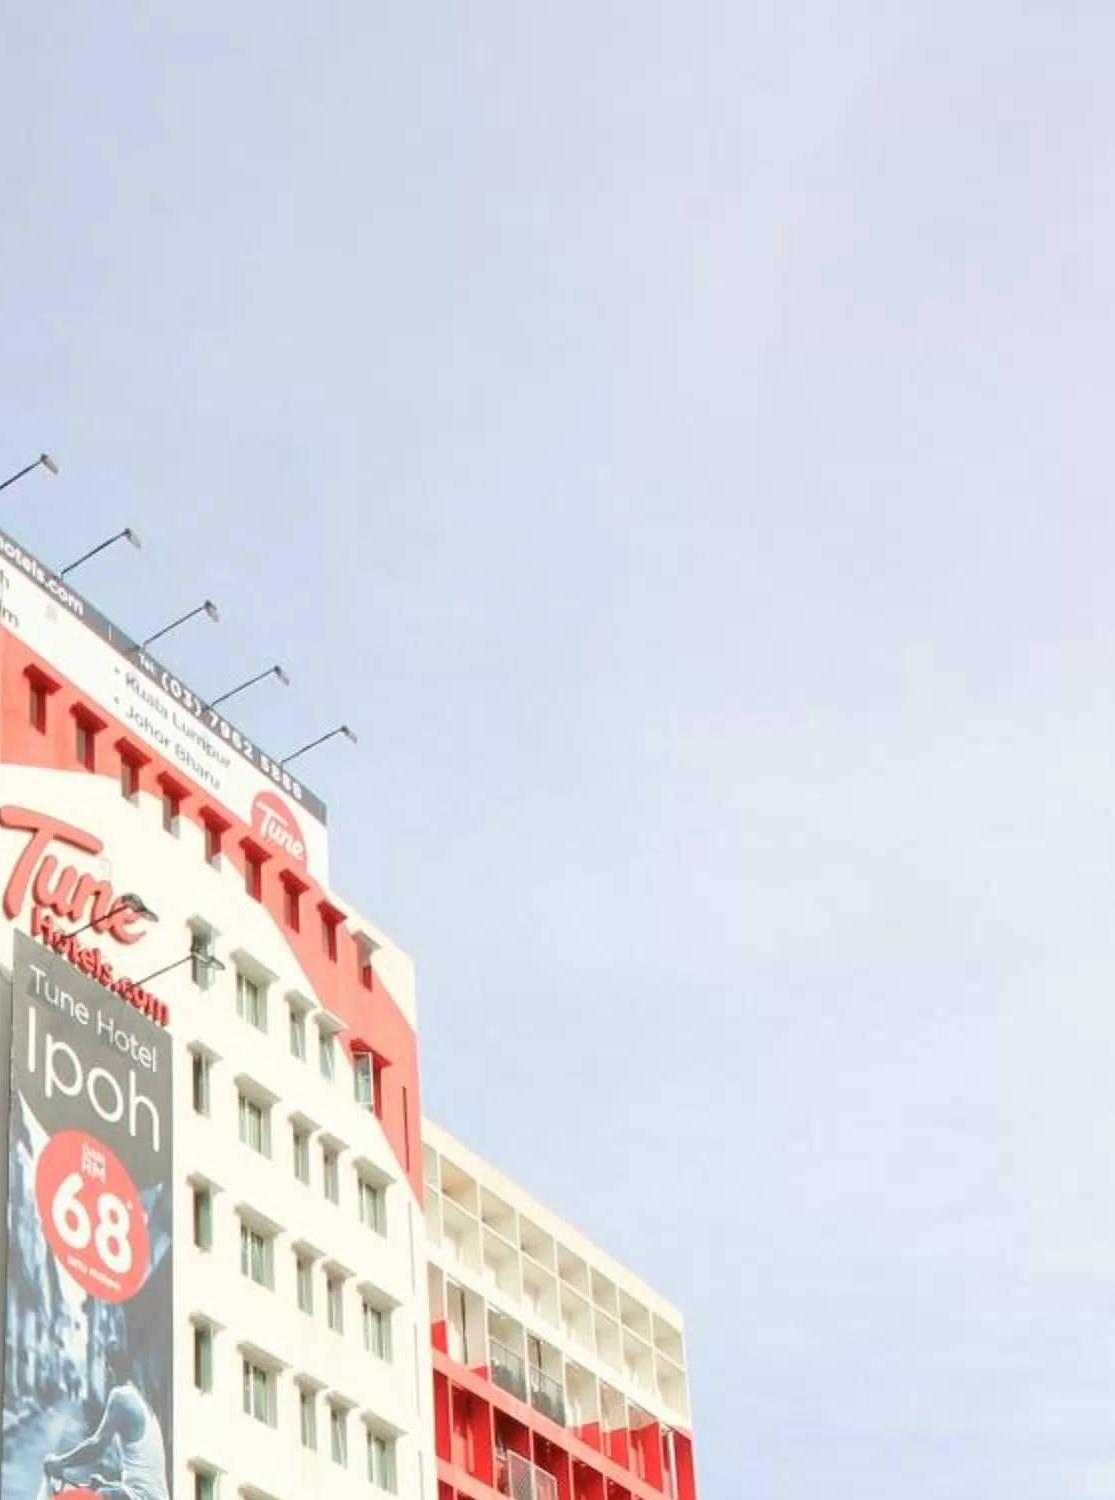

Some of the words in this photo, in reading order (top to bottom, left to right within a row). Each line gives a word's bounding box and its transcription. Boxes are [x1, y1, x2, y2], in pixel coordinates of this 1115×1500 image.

[126, 705, 170, 749] Johor
[30, 964, 90, 1025] Tune
[97, 1008, 157, 1073] Hotel
[28, 1006, 160, 1152] Ipoh
[52, 1171, 133, 1274] 68
